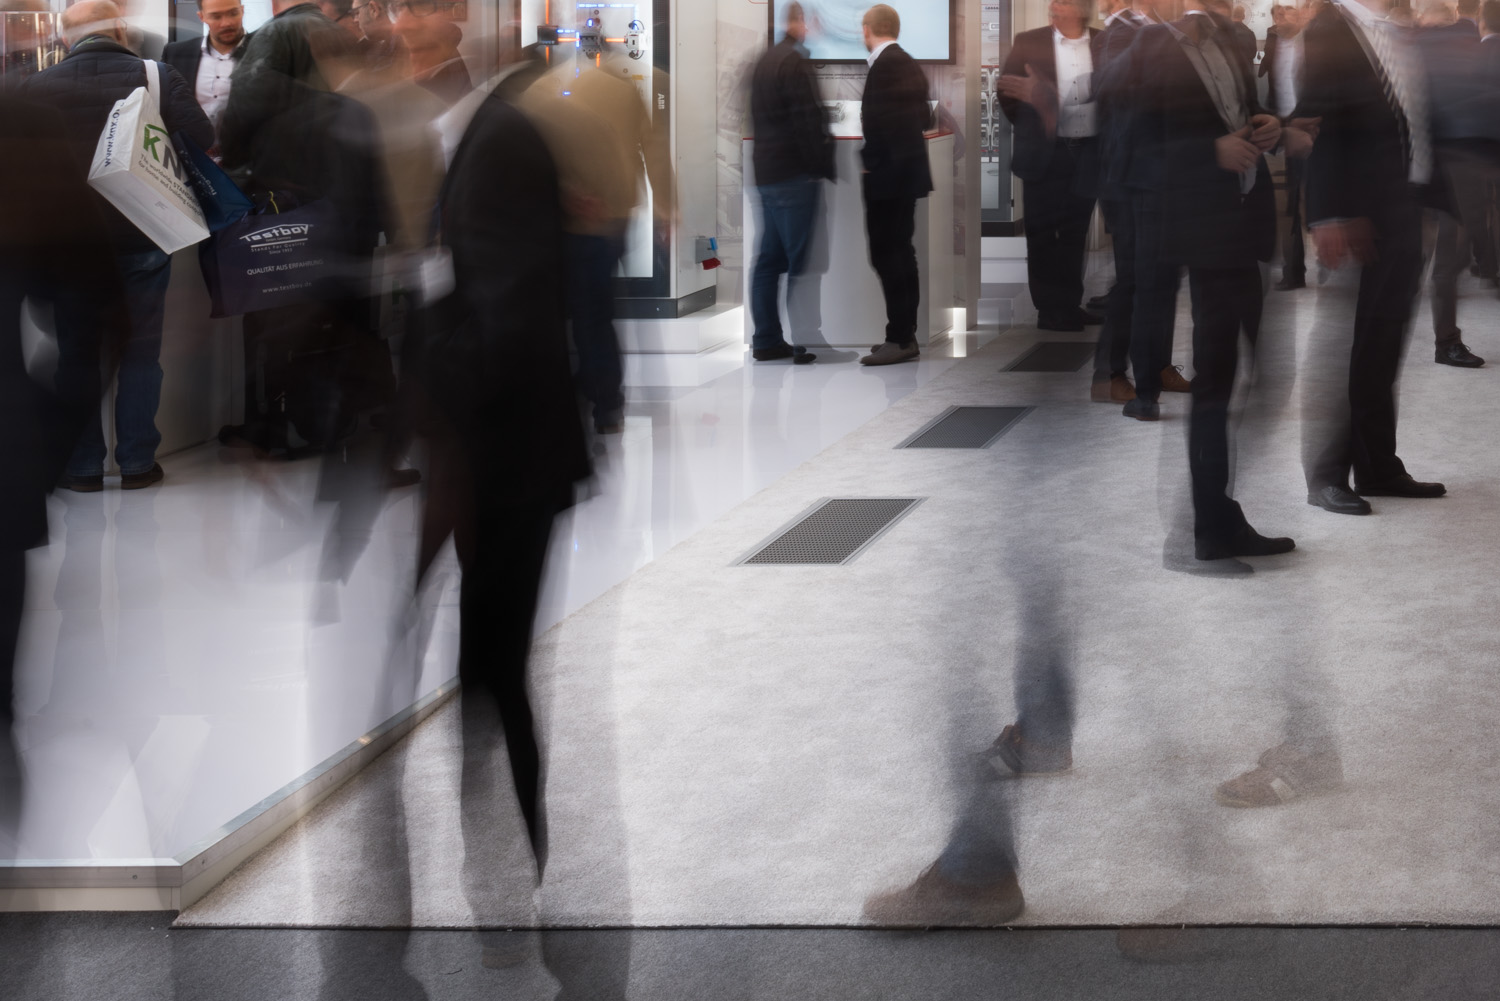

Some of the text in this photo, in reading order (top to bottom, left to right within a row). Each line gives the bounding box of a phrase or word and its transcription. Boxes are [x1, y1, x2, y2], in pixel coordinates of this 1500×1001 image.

[104, 102, 125, 167] www.knx.o
[240, 224, 309, 242] Testboy
[247, 265, 275, 275] QUALITÄT
[289, 259, 324, 269] ERFAHRUNG
